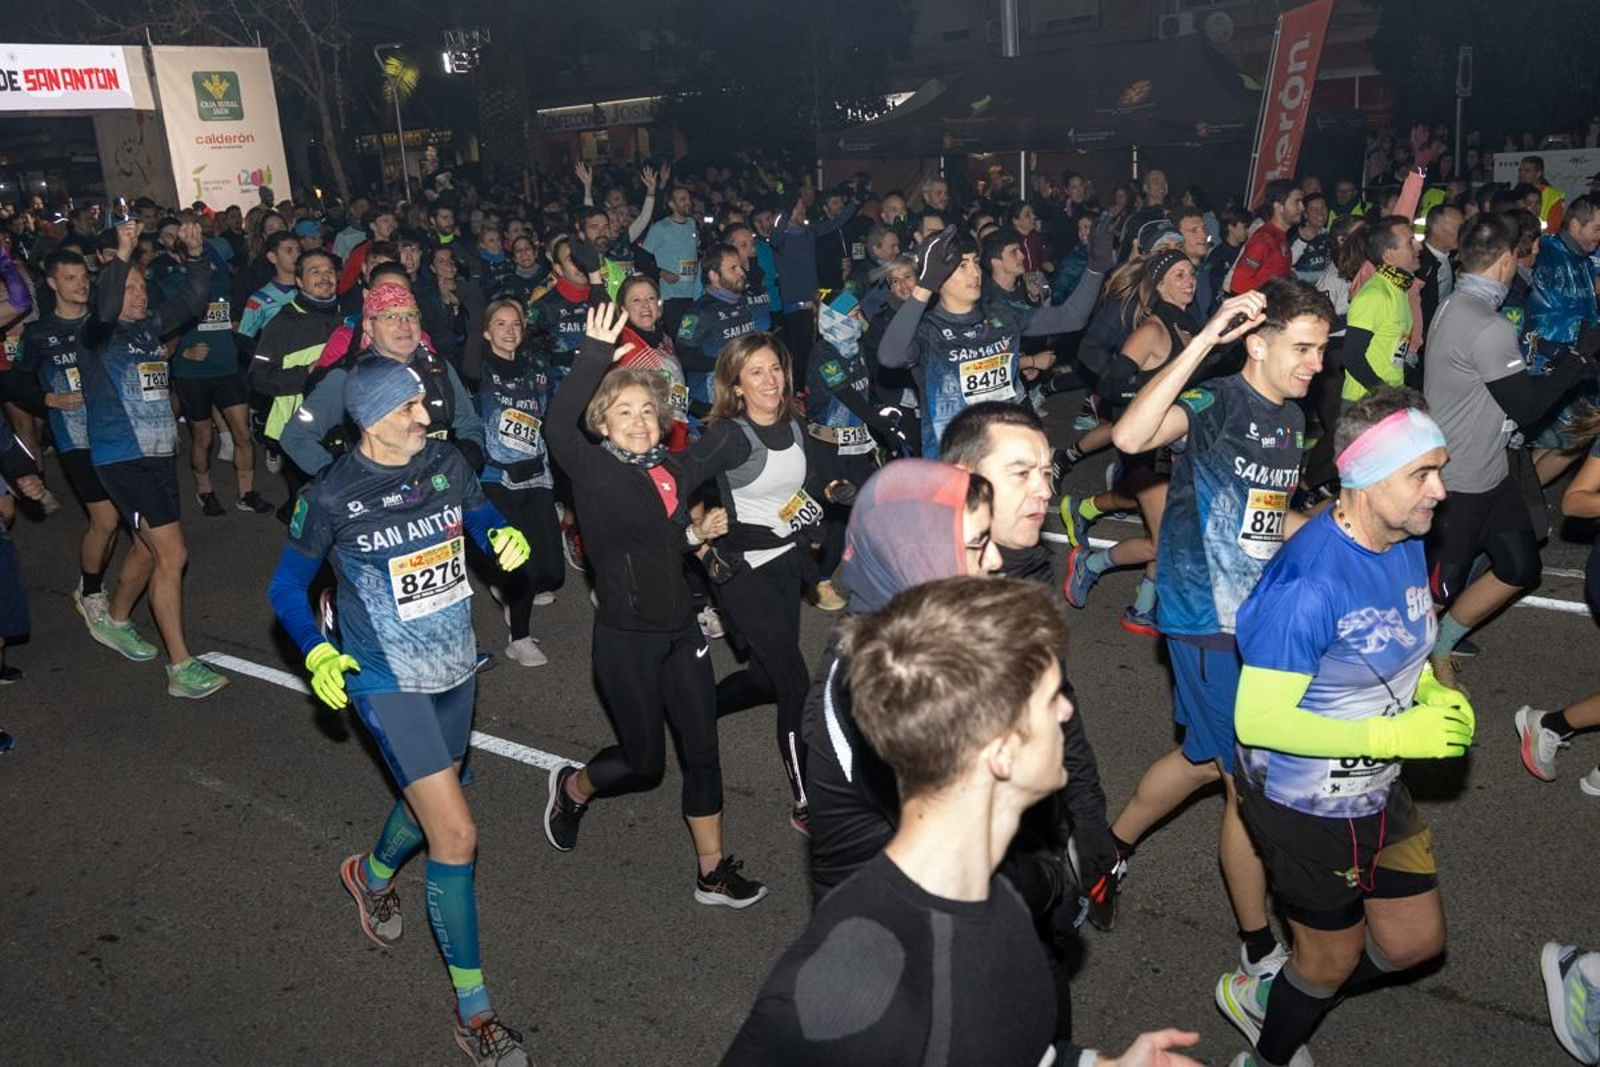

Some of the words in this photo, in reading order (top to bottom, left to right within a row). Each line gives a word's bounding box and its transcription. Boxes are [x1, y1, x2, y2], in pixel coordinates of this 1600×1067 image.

[23, 69, 60, 91] SAN
[195, 133, 255, 145] calderón
[559, 322, 581, 333] SAN
[723, 326, 742, 340] SAN
[53, 351, 77, 365] SAN
[966, 366, 1007, 391] 8479
[504, 419, 537, 441] 7815
[1233, 456, 1269, 485] SAN
[356, 525, 404, 553] SAN
[407, 504, 463, 541] ANTÓN
[1251, 510, 1287, 534] 827
[401, 556, 461, 595] 8276
